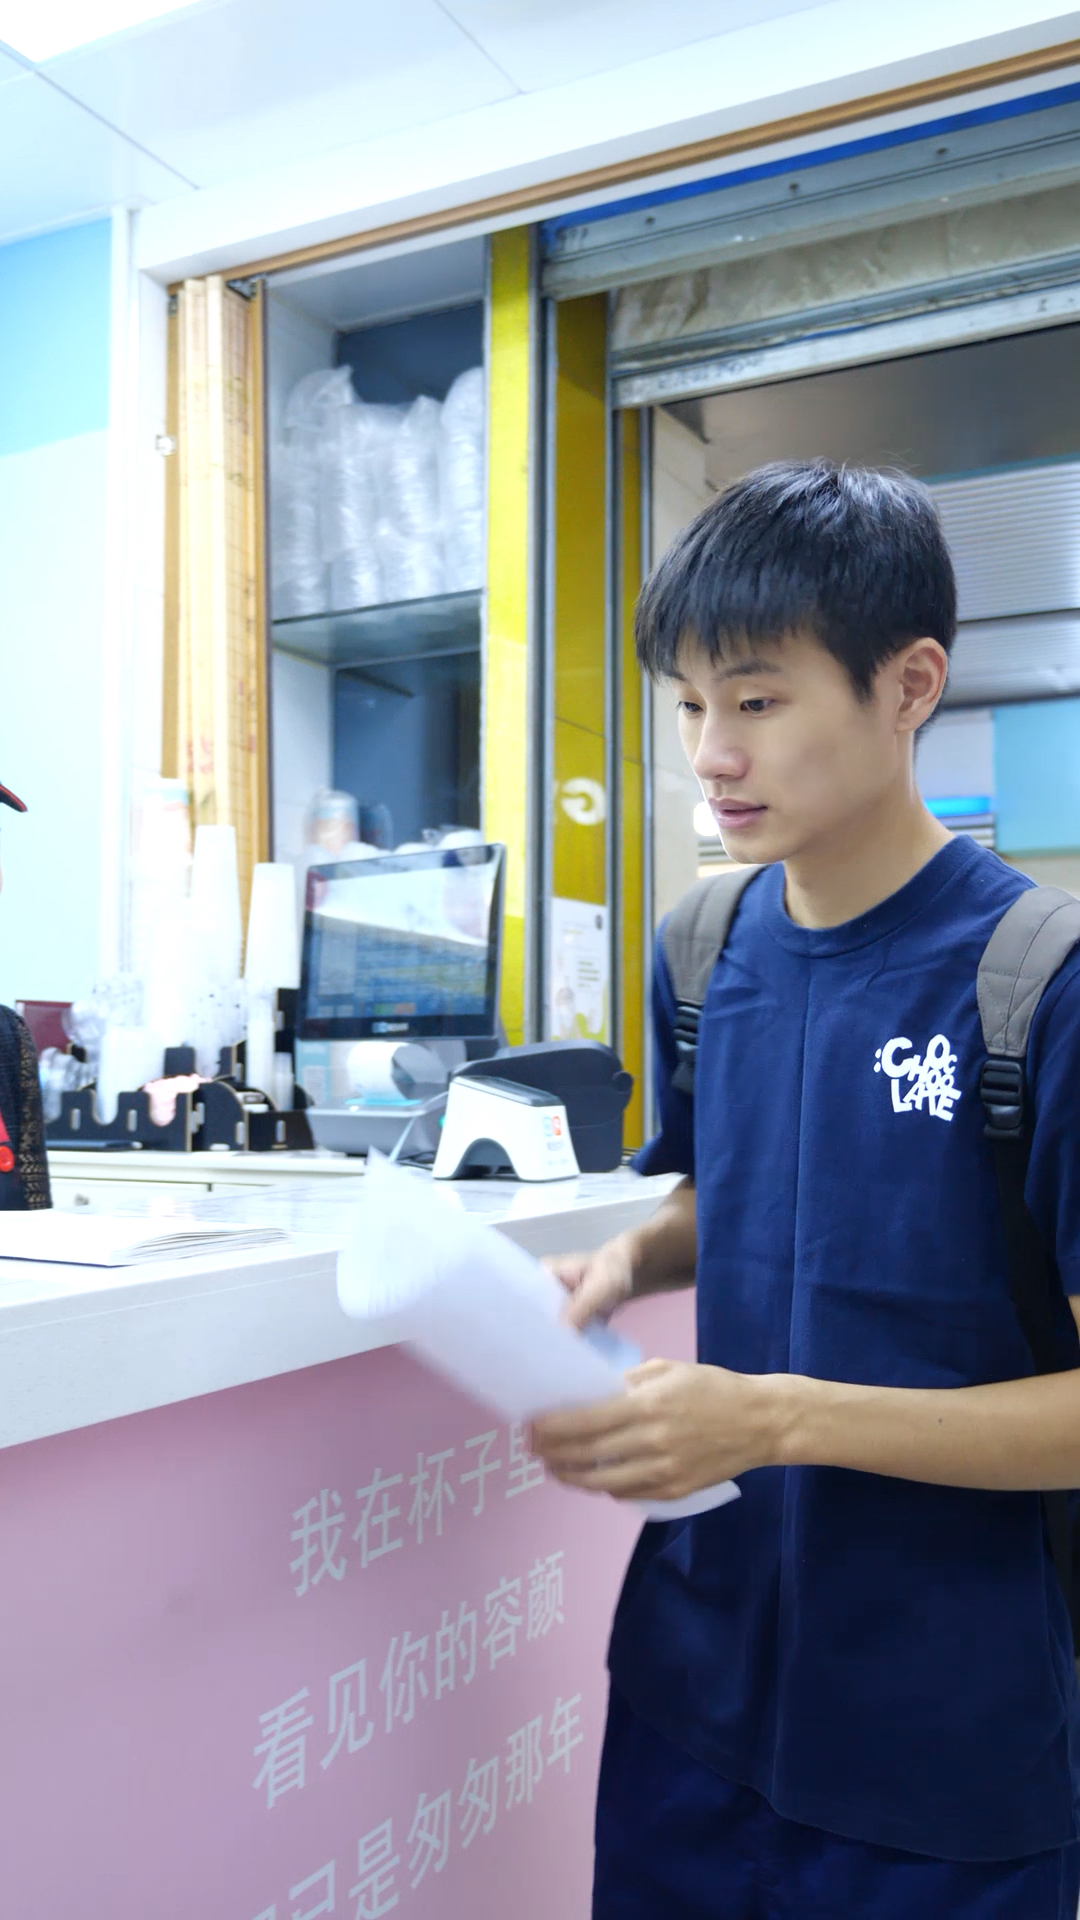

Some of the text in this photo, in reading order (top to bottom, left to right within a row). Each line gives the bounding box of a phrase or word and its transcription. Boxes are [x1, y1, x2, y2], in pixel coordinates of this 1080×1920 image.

[289, 1423, 545, 1597] 我在杯子里
[251, 1550, 565, 1809] 看见你的容颜
[252, 1693, 584, 1920] 已是匆匆那年
